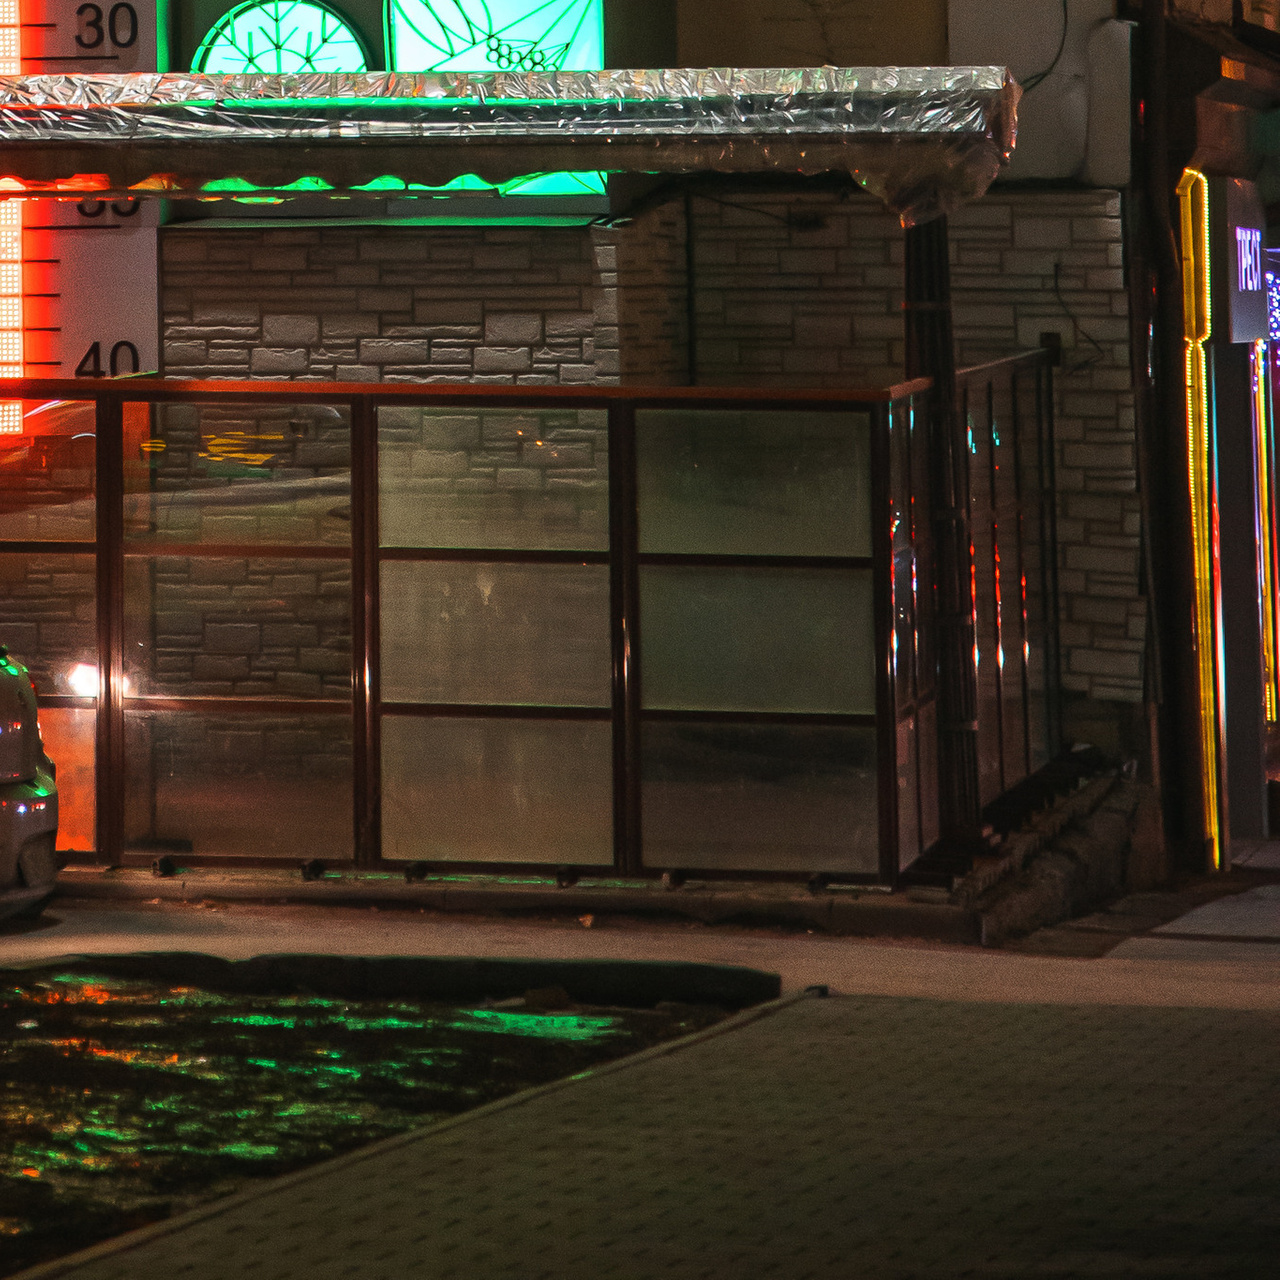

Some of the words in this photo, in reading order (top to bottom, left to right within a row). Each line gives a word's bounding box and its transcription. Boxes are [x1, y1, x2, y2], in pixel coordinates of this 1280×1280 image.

[74, 2, 138, 48] 30
[1236, 226, 1262, 291] ТРЕСТ
[75, 341, 139, 377] 40
